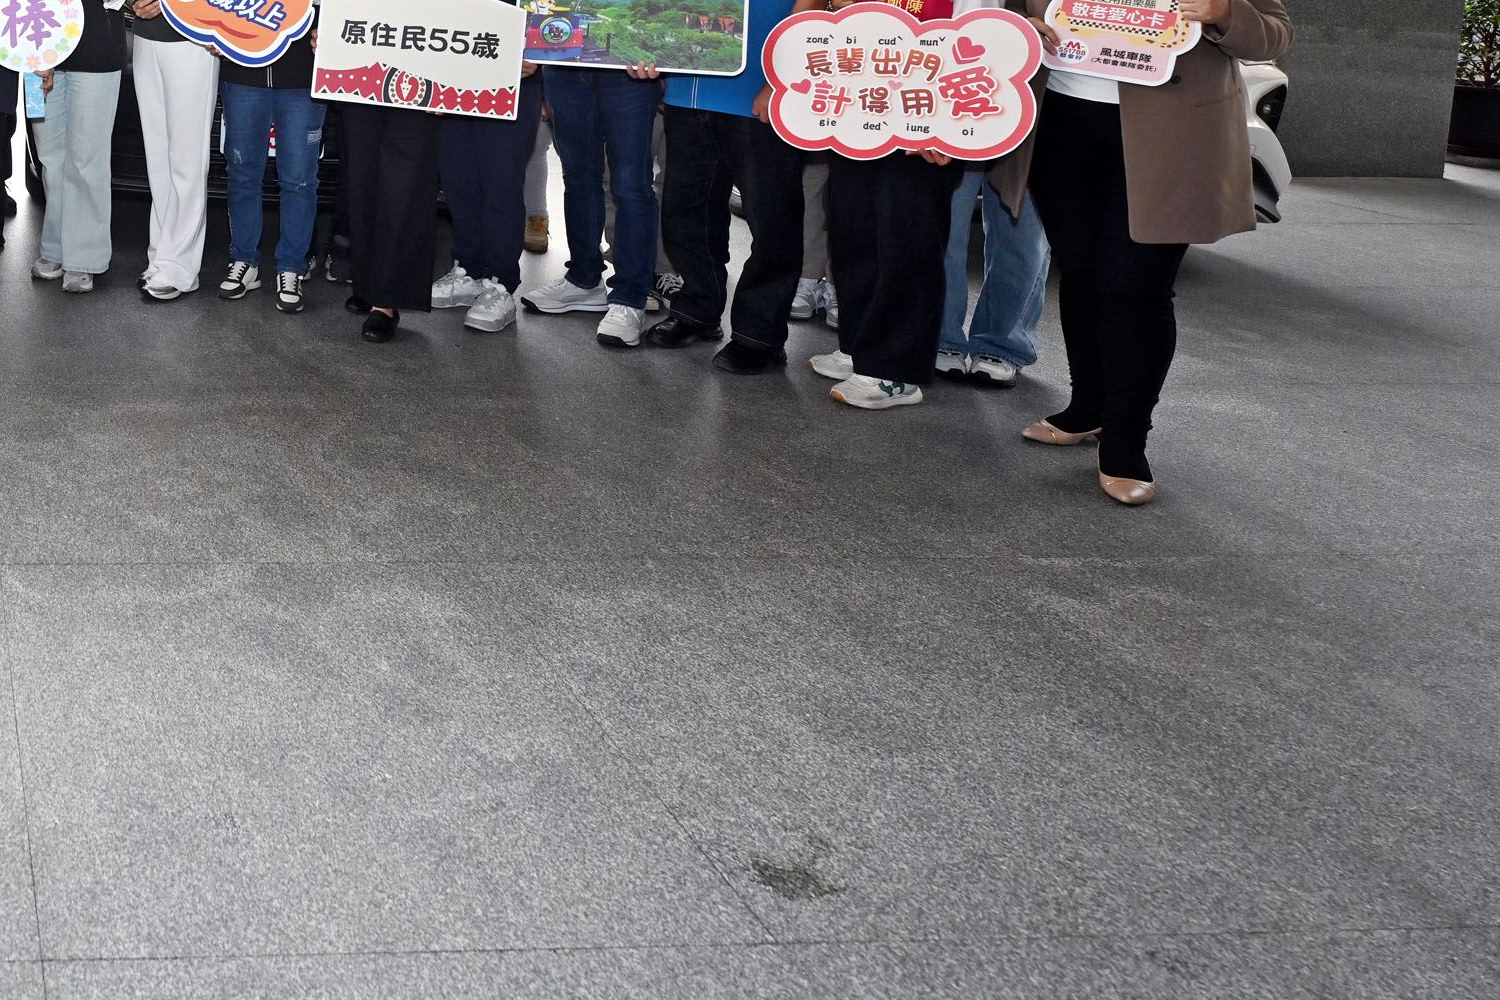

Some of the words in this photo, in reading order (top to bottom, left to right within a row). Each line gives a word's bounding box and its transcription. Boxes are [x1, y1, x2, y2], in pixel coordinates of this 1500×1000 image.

[1071, 2, 1165, 26] 敬老愛心卡
[340, 19, 500, 60] 原住民55歲
[846, 36, 857, 44] bi
[1059, 46, 1086, 56] 551788
[1099, 47, 1152, 63] 風城車隊
[805, 47, 941, 81] 長輩出門
[819, 118, 837, 127] gie
[906, 123, 930, 133] iung
[962, 128, 974, 136] oi
